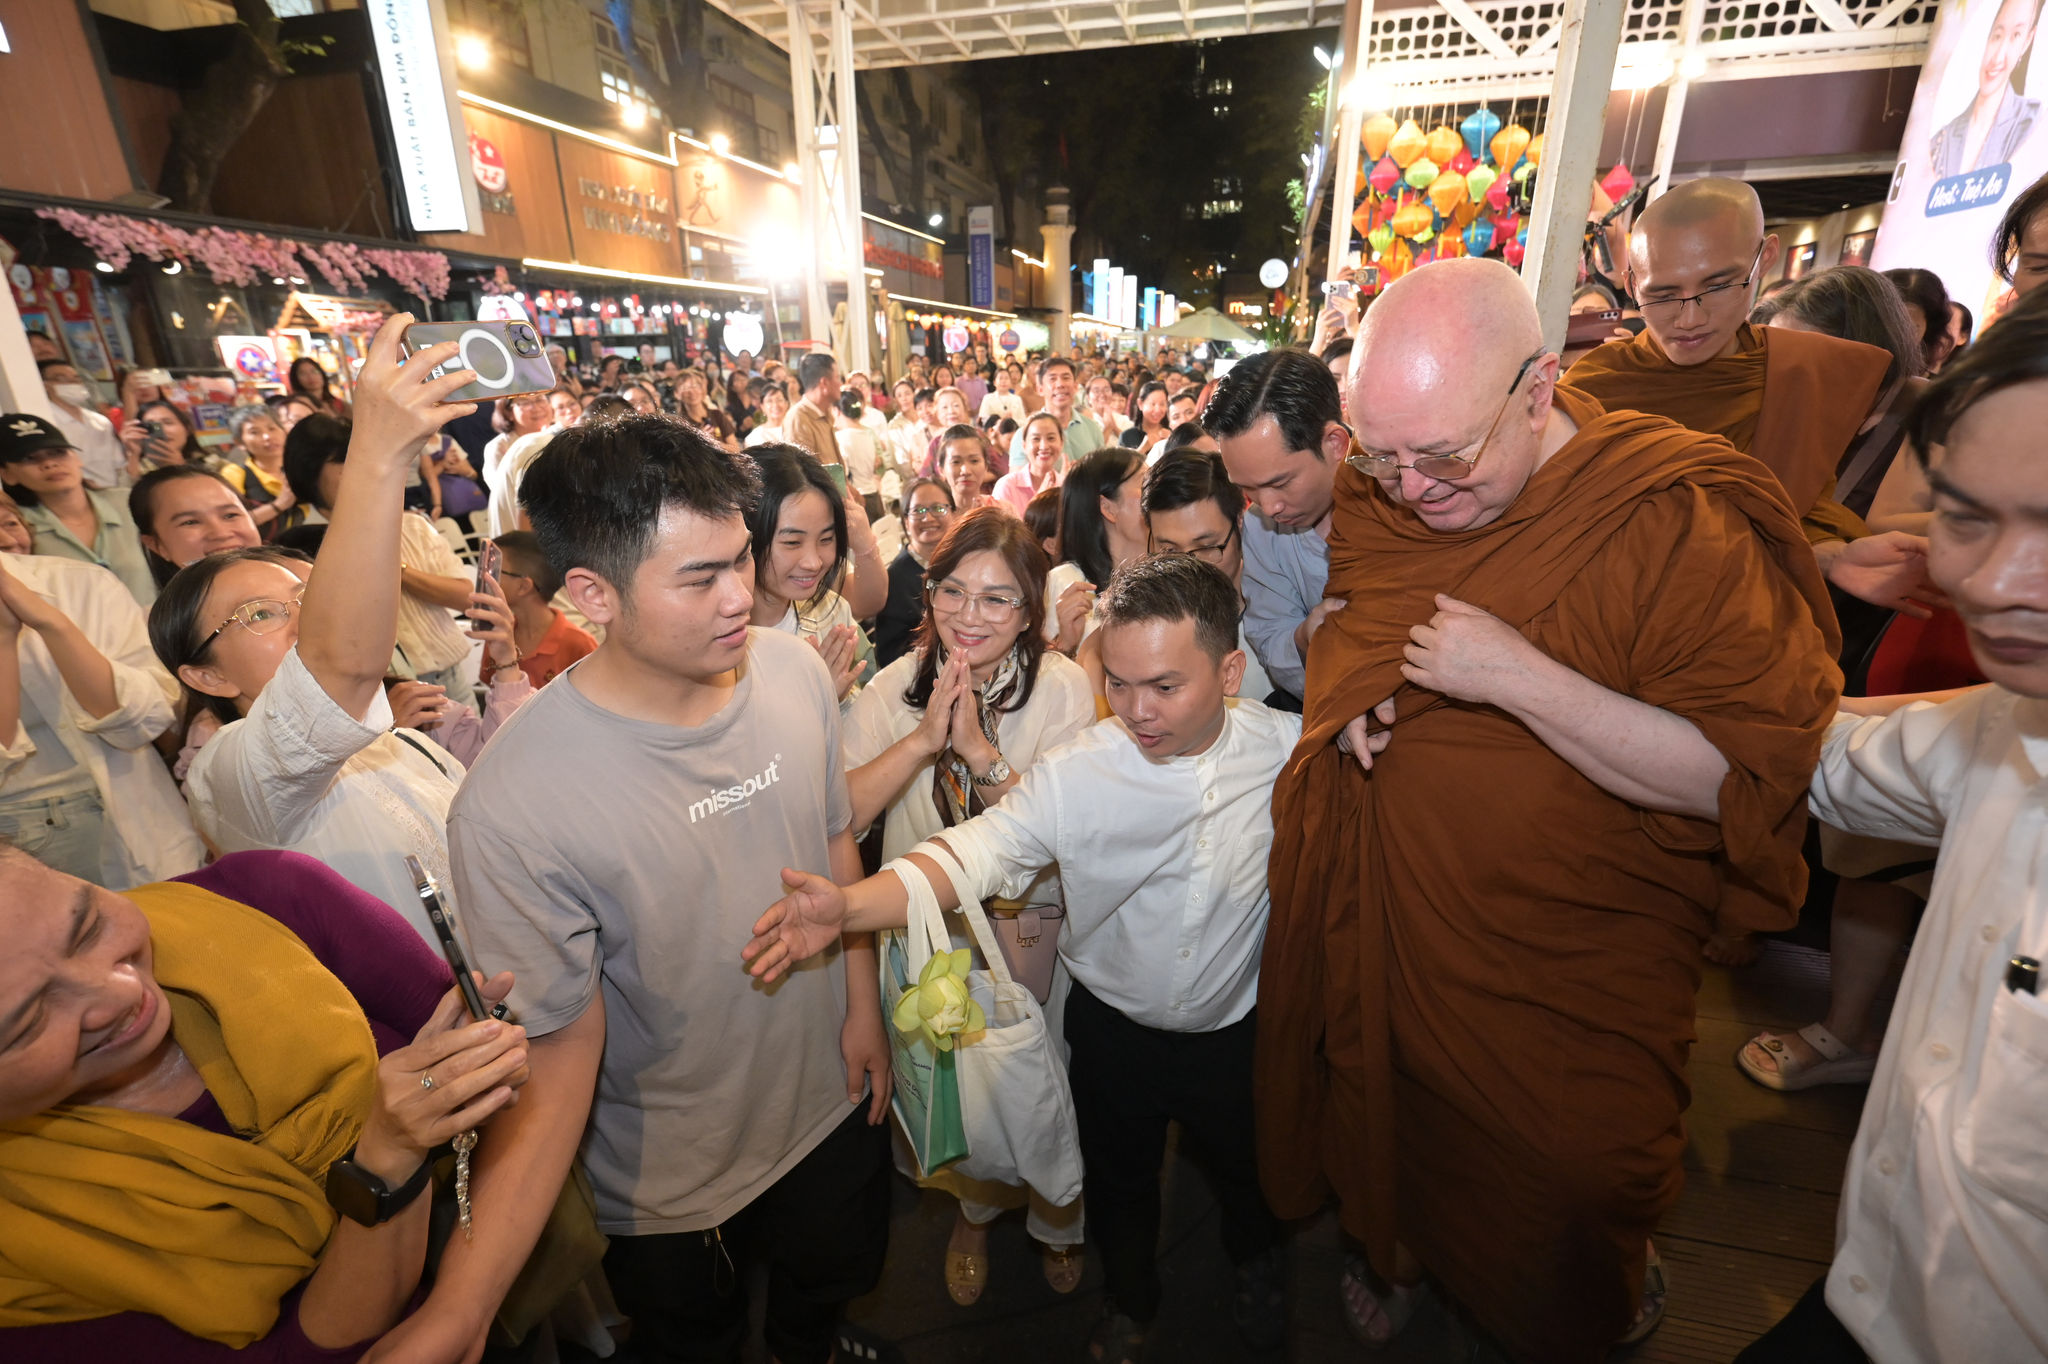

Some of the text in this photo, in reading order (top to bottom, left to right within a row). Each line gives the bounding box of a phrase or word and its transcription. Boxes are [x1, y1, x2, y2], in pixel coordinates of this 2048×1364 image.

[1928, 184, 1960, 209] Host:
[1980, 172, 2003, 198] An
[688, 761, 780, 824] missout
